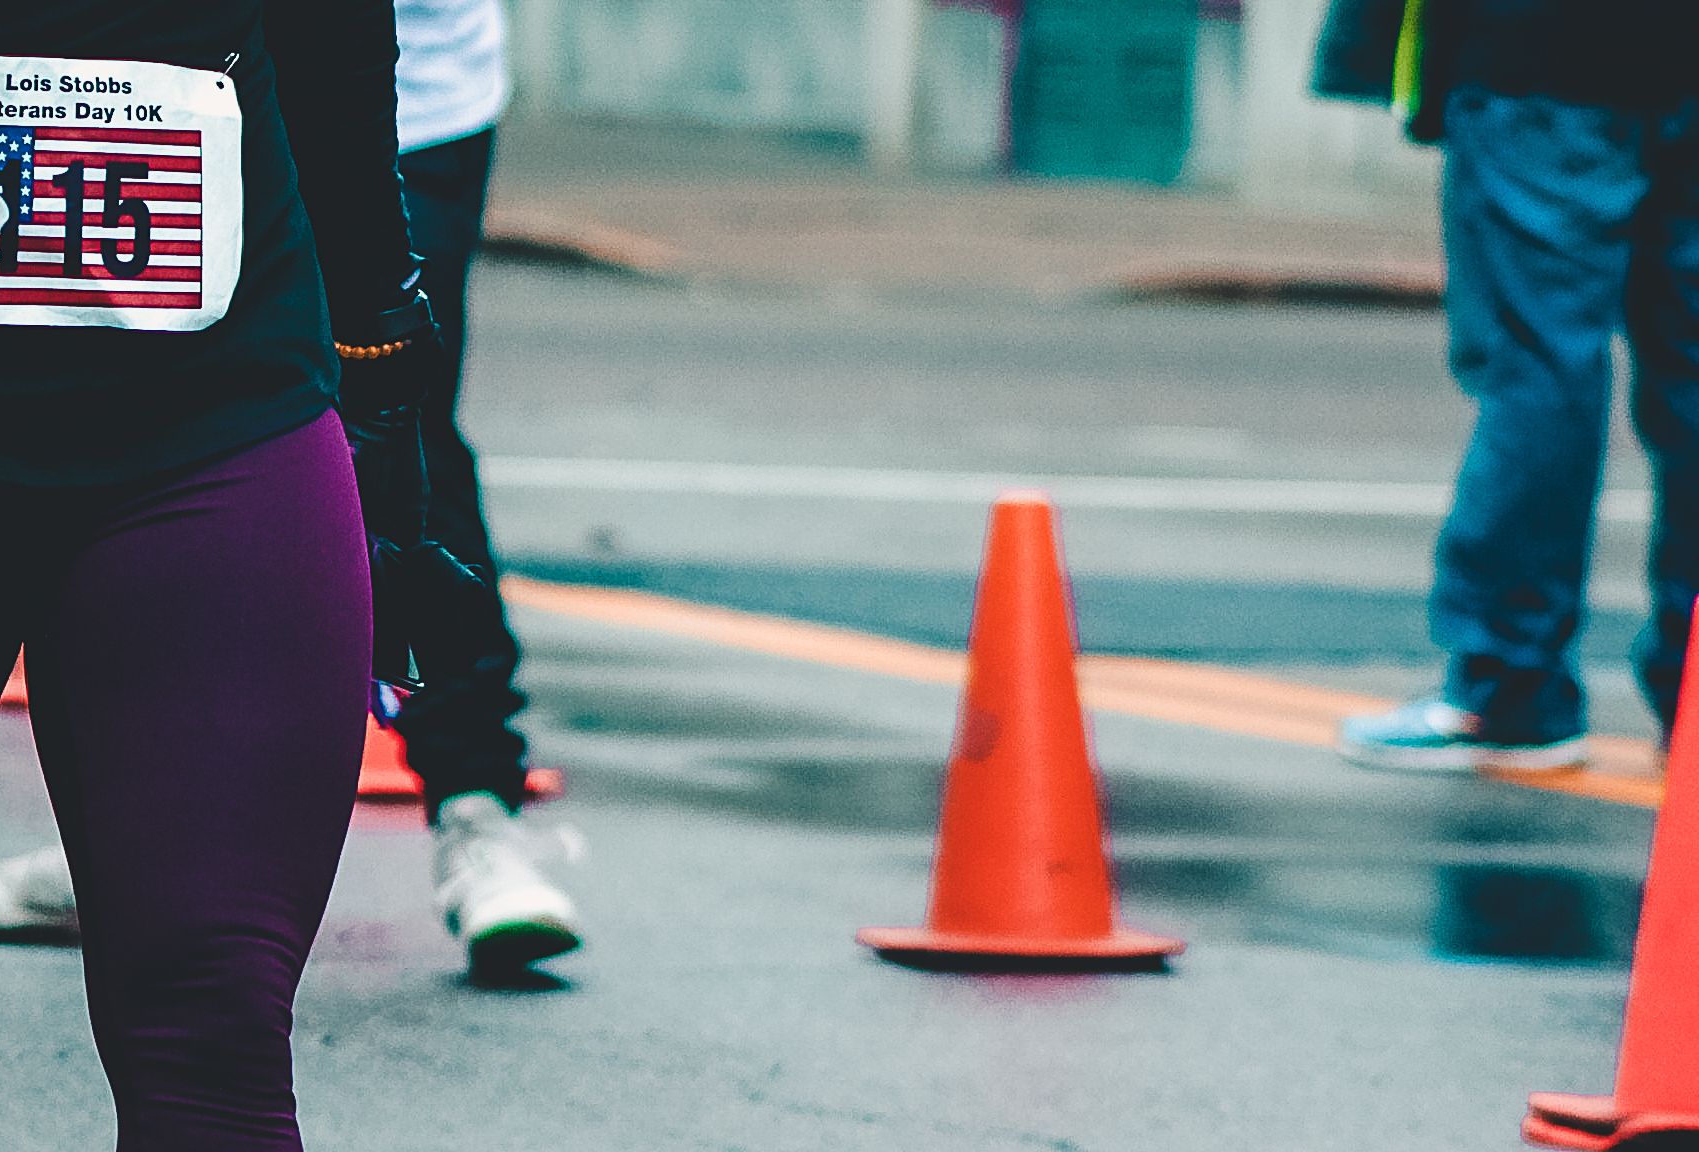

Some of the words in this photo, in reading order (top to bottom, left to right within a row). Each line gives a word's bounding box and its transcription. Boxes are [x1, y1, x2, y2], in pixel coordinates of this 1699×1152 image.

[6, 74, 51, 92] Lois
[59, 76, 132, 94] Stobbs
[75, 103, 115, 123] Day
[124, 105, 163, 122] 10K
